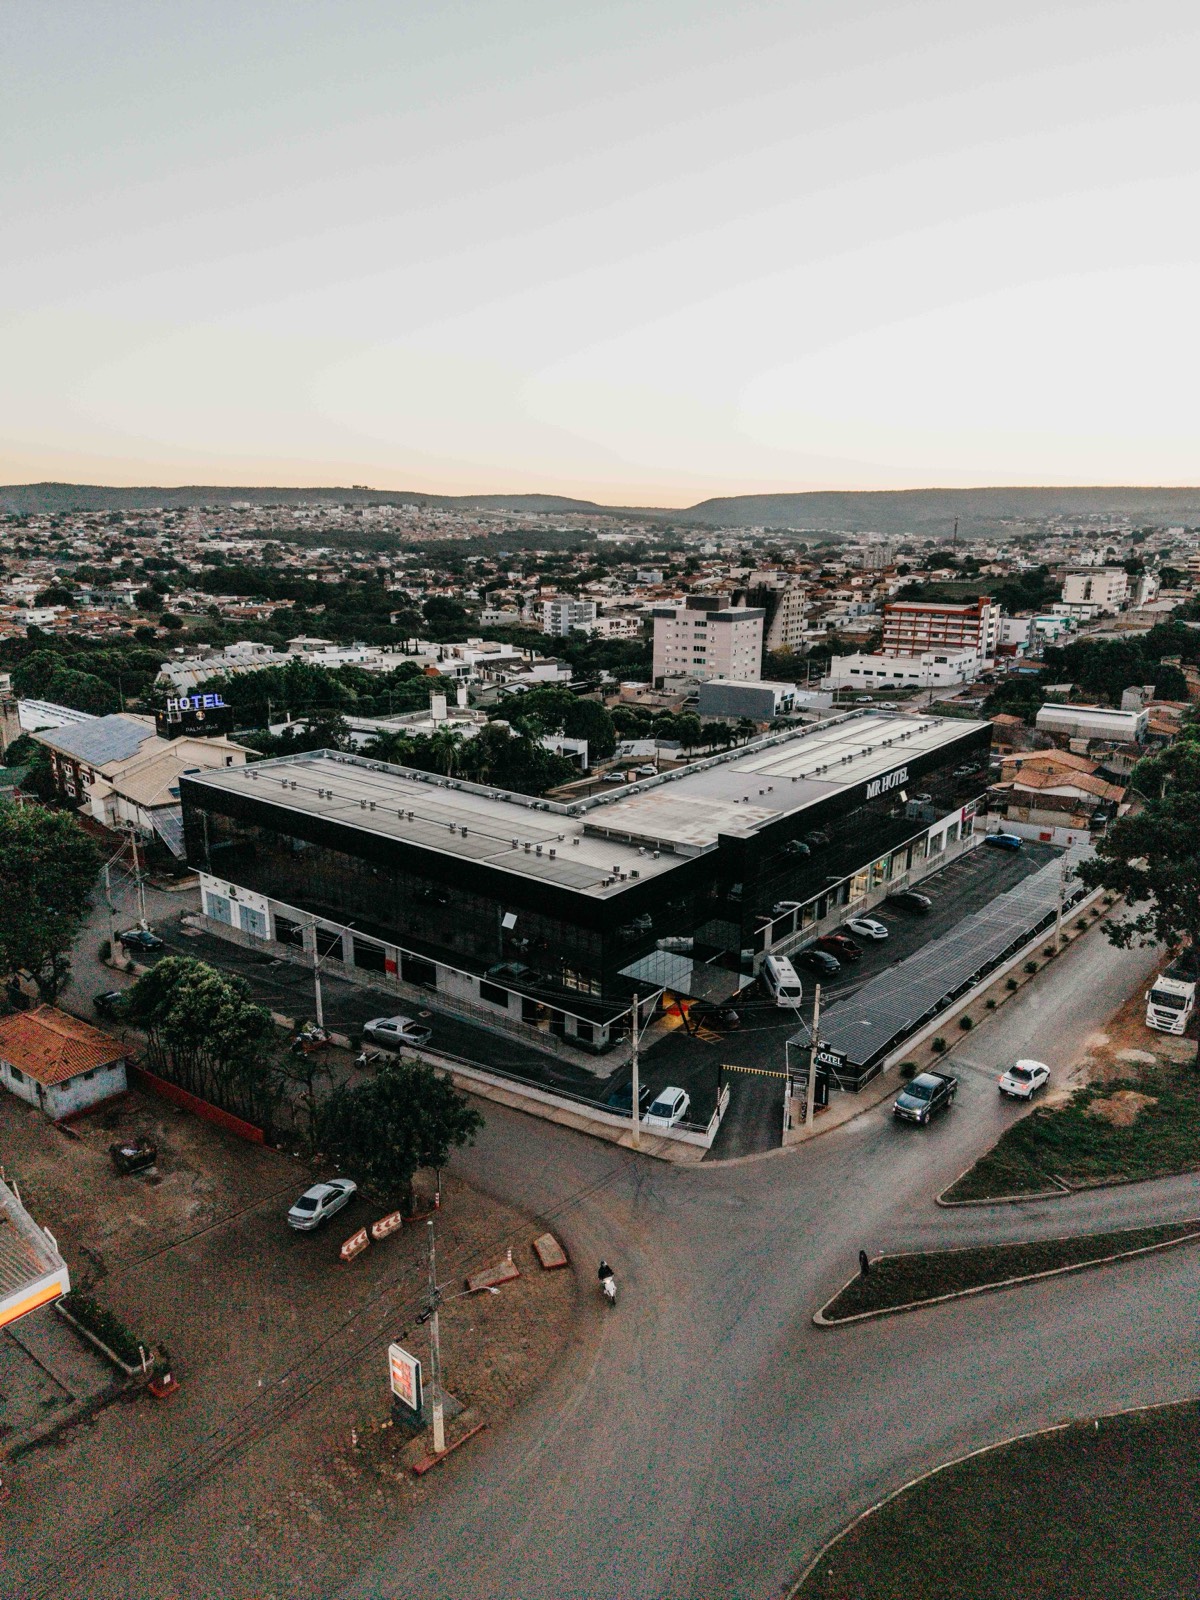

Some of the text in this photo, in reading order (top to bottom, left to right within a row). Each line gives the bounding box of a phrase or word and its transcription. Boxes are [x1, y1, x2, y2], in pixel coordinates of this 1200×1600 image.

[166, 693, 225, 712] HOTEL
[866, 766, 909, 800] MR HOTEL
